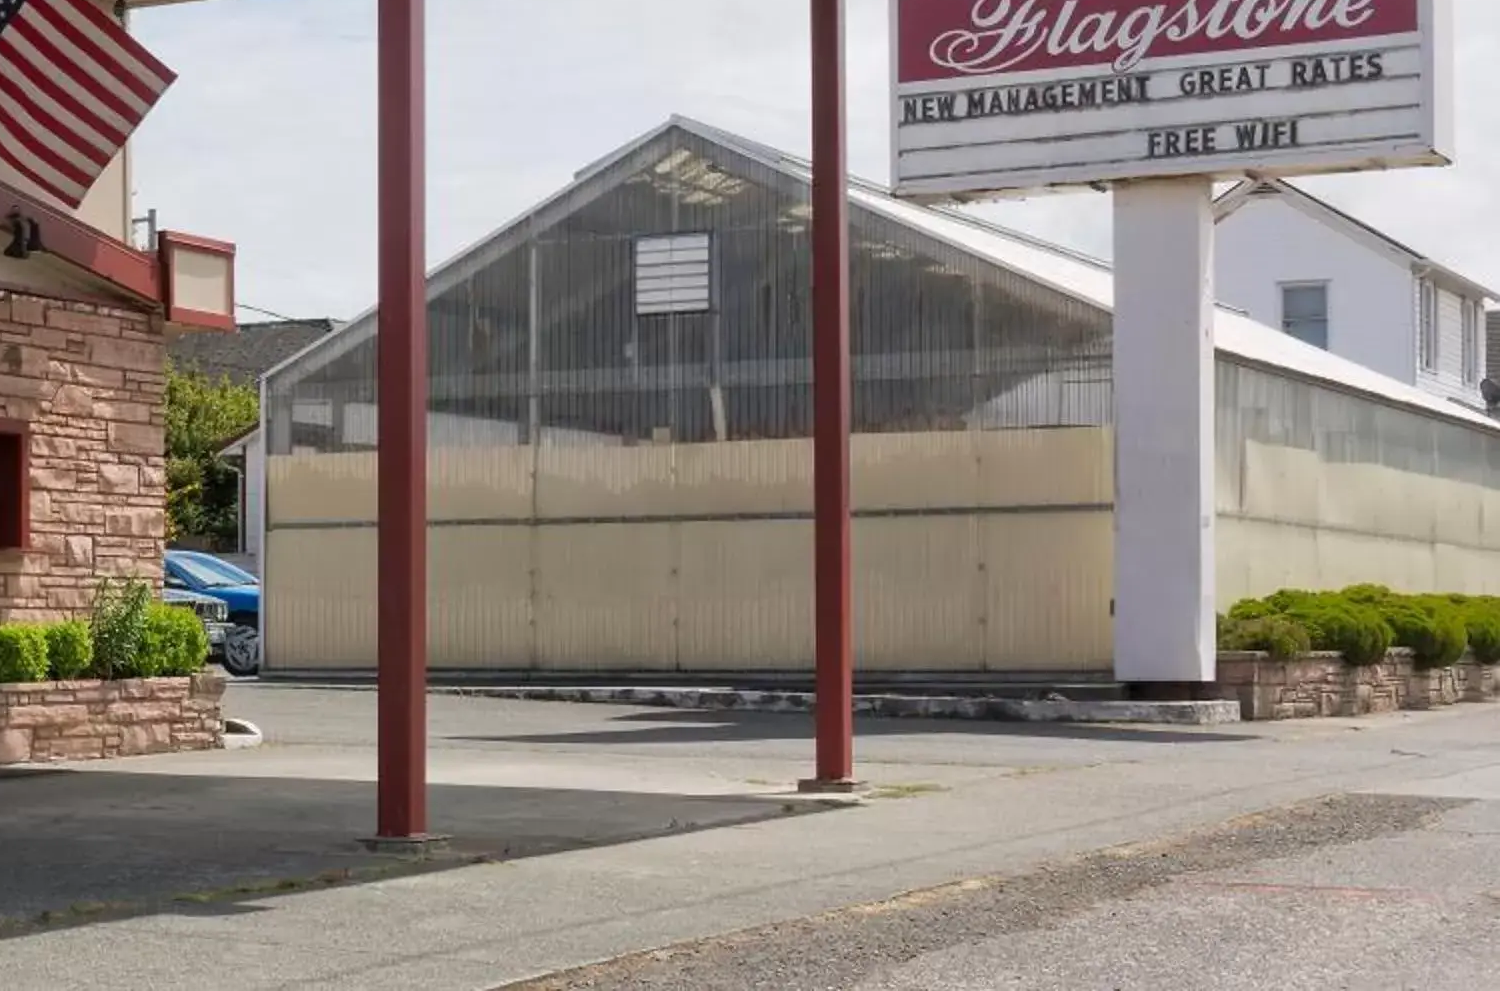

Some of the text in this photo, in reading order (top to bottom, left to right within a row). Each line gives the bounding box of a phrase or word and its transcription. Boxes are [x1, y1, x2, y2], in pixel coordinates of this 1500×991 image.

[903, 53, 1384, 124] NEW MANAGEMENT GREAT RATES
[1148, 120, 1299, 158] FREE WIFI
